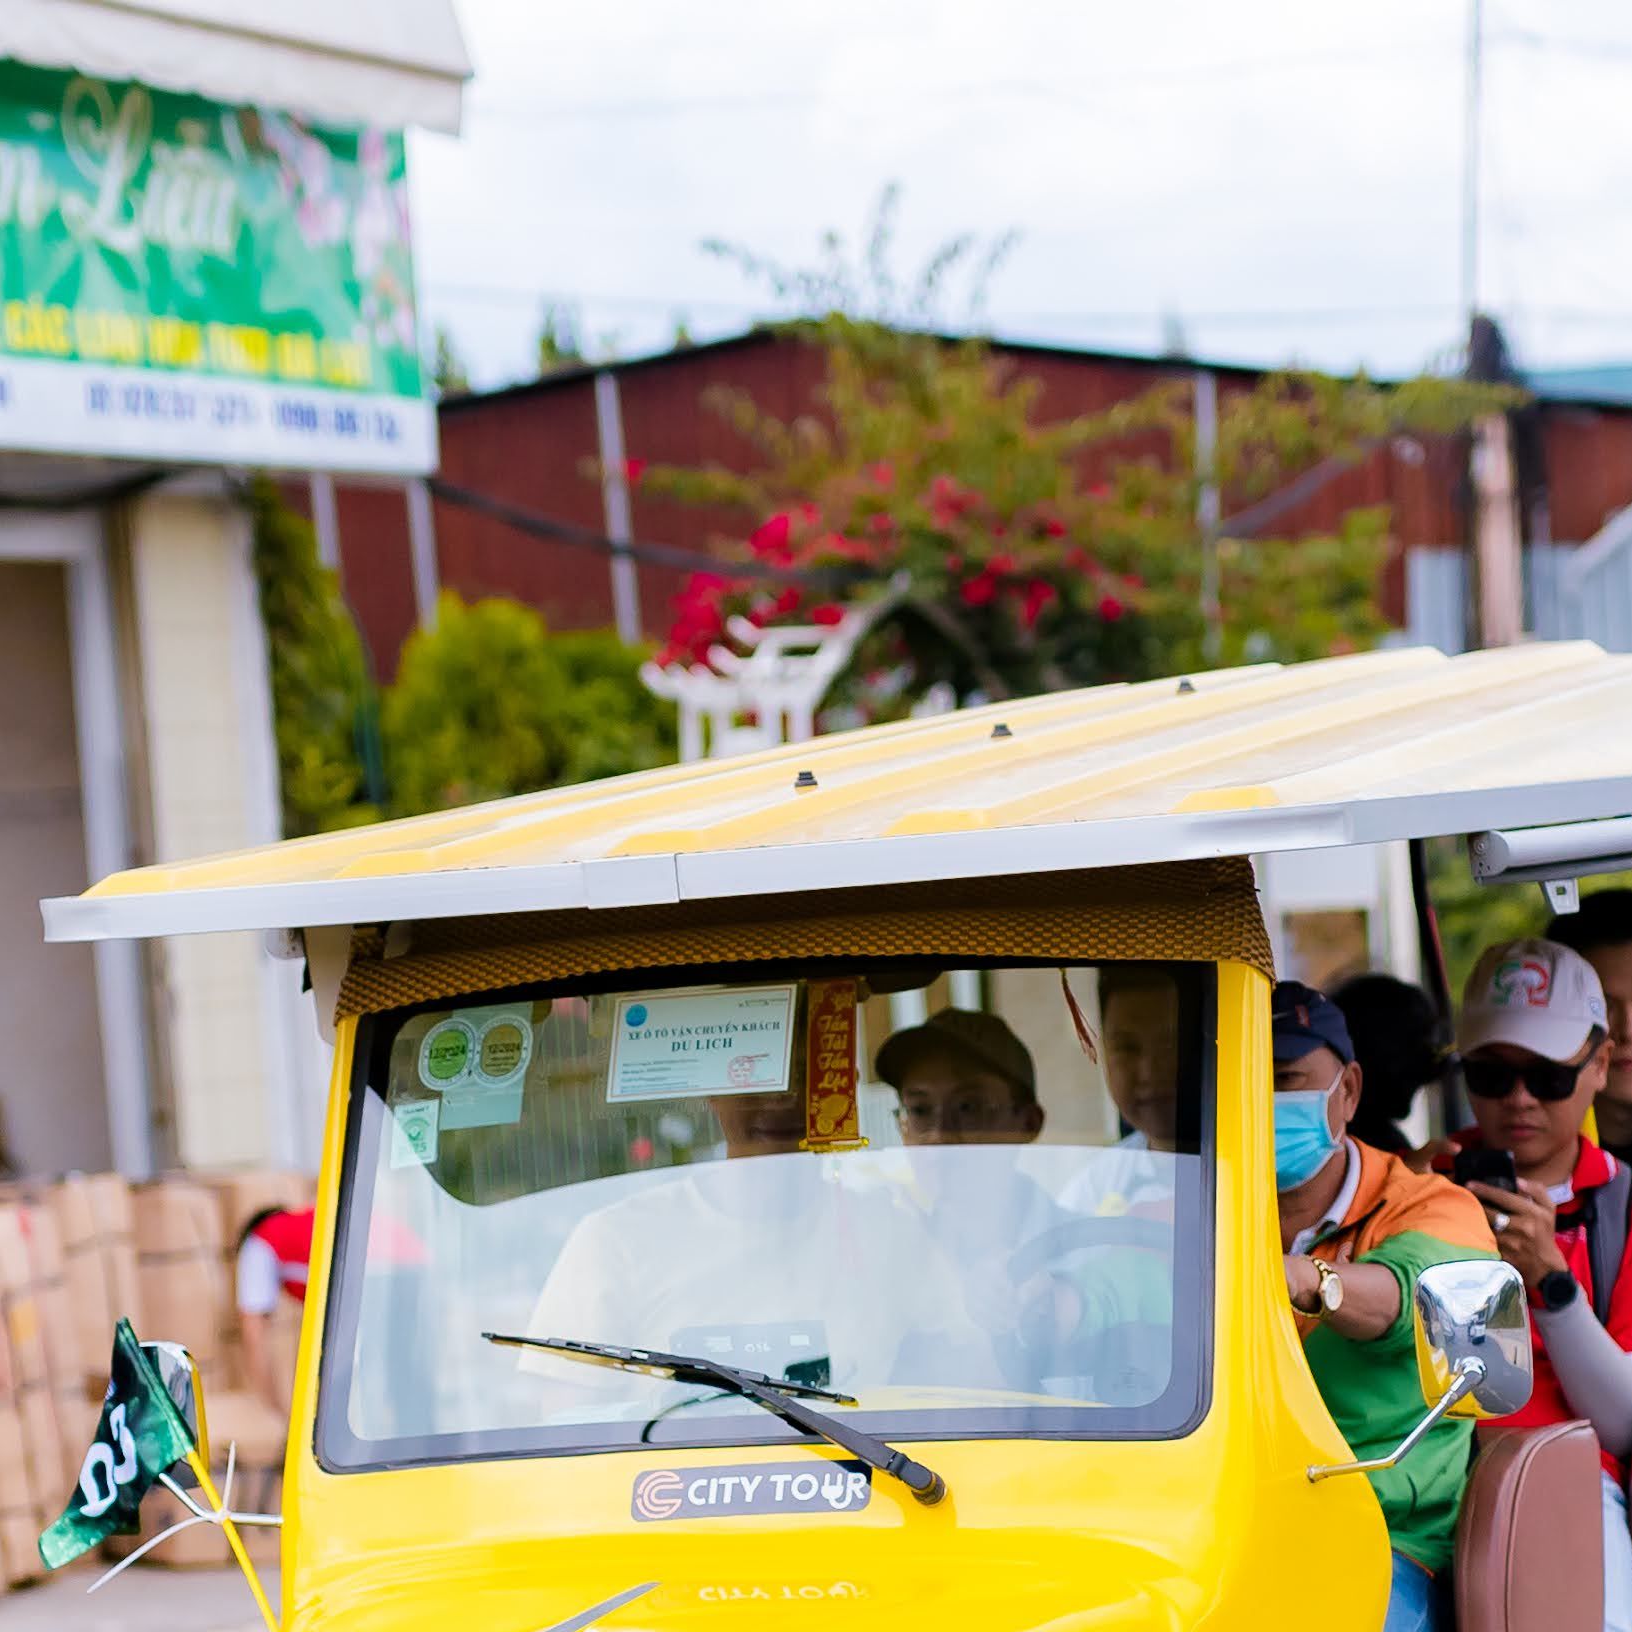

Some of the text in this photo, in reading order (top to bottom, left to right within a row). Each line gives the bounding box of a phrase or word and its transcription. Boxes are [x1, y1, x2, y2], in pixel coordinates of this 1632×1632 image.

[672, 1040, 692, 1051] DU
[687, 1472, 868, 1510] CITY TOUR
